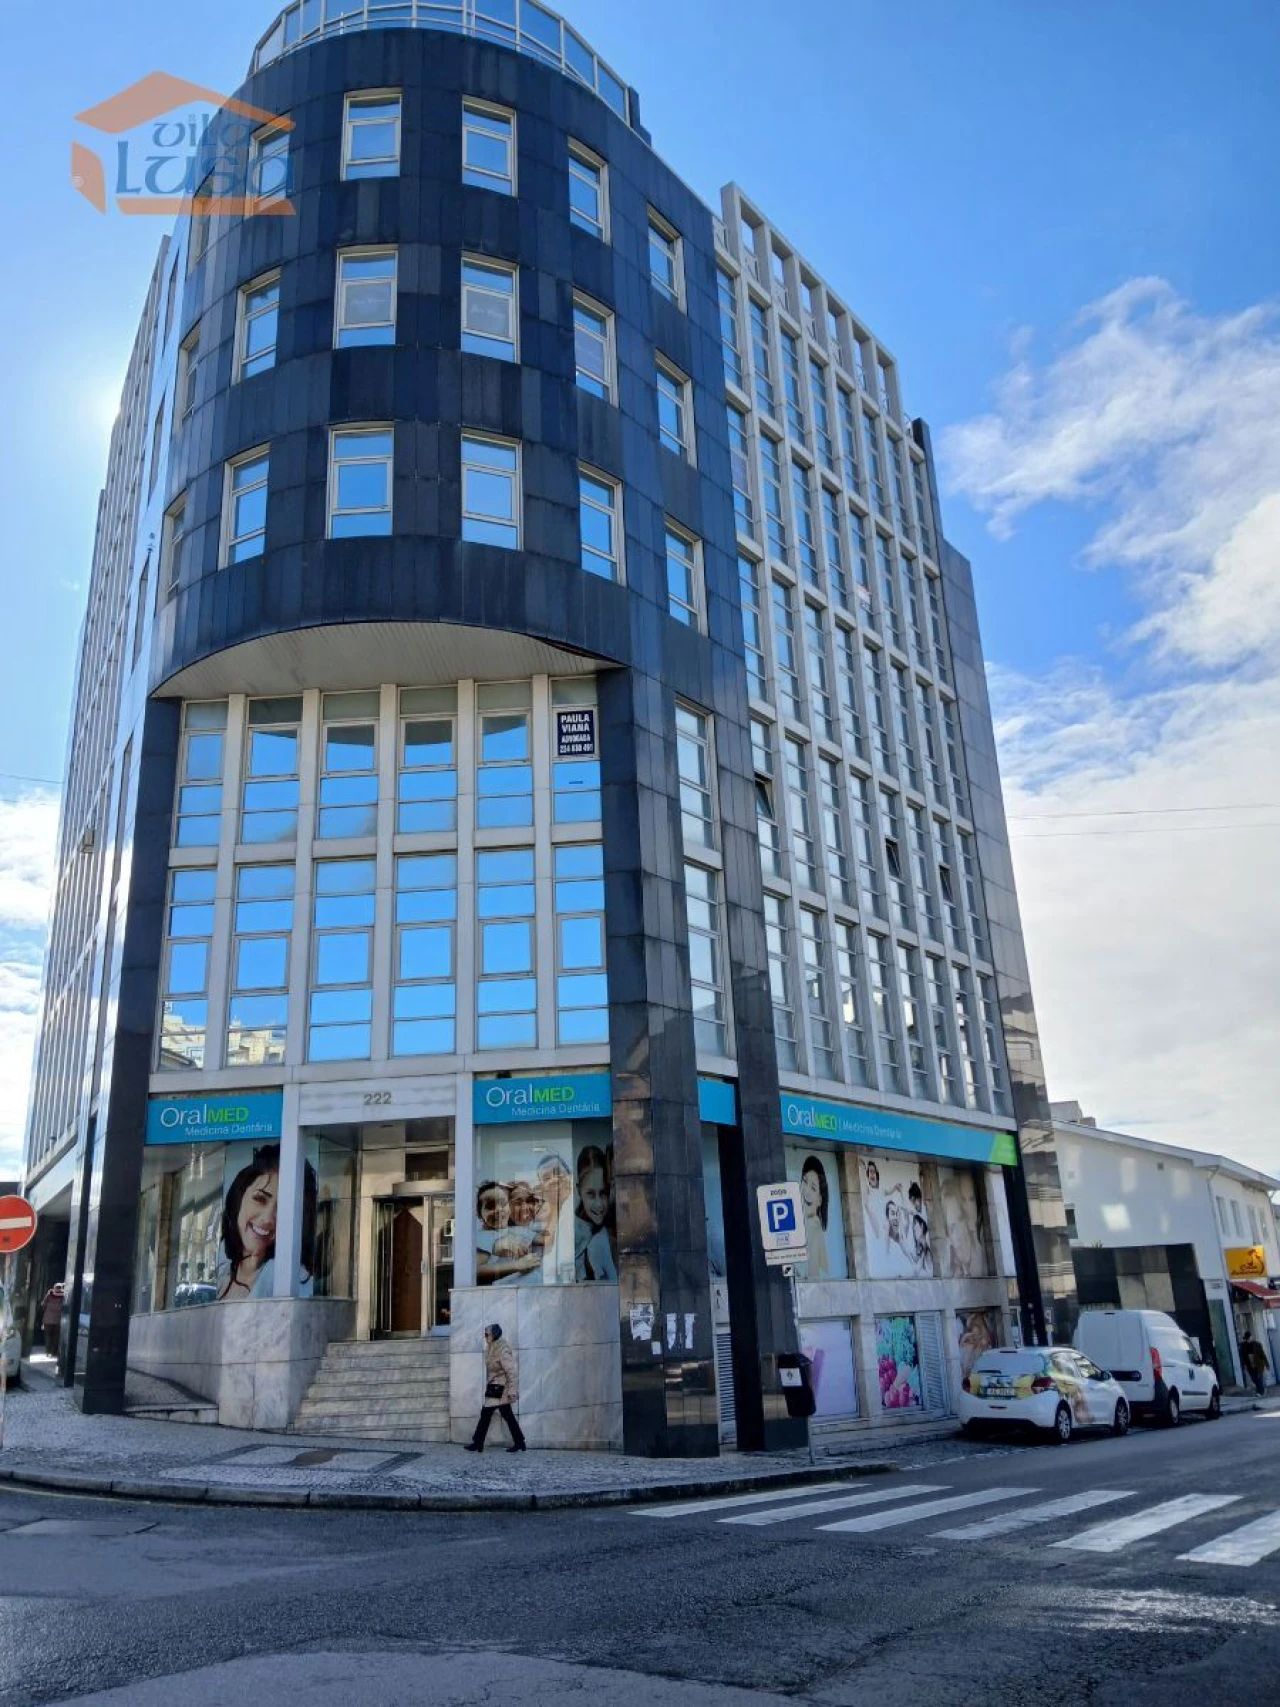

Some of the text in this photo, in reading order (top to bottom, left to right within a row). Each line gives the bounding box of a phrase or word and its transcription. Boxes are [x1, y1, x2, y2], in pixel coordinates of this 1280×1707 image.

[561, 713, 590, 724] PAULA
[561, 723, 590, 733] VIANA
[363, 1092, 392, 1106] 222
[484, 1083, 575, 1108] OralMED
[160, 1103, 250, 1128] OralMED
[511, 1106, 557, 1117] Medicina
[787, 1103, 837, 1133] OralMED
[184, 1126, 229, 1137] Medicina
[772, 1202, 789, 1230] P
